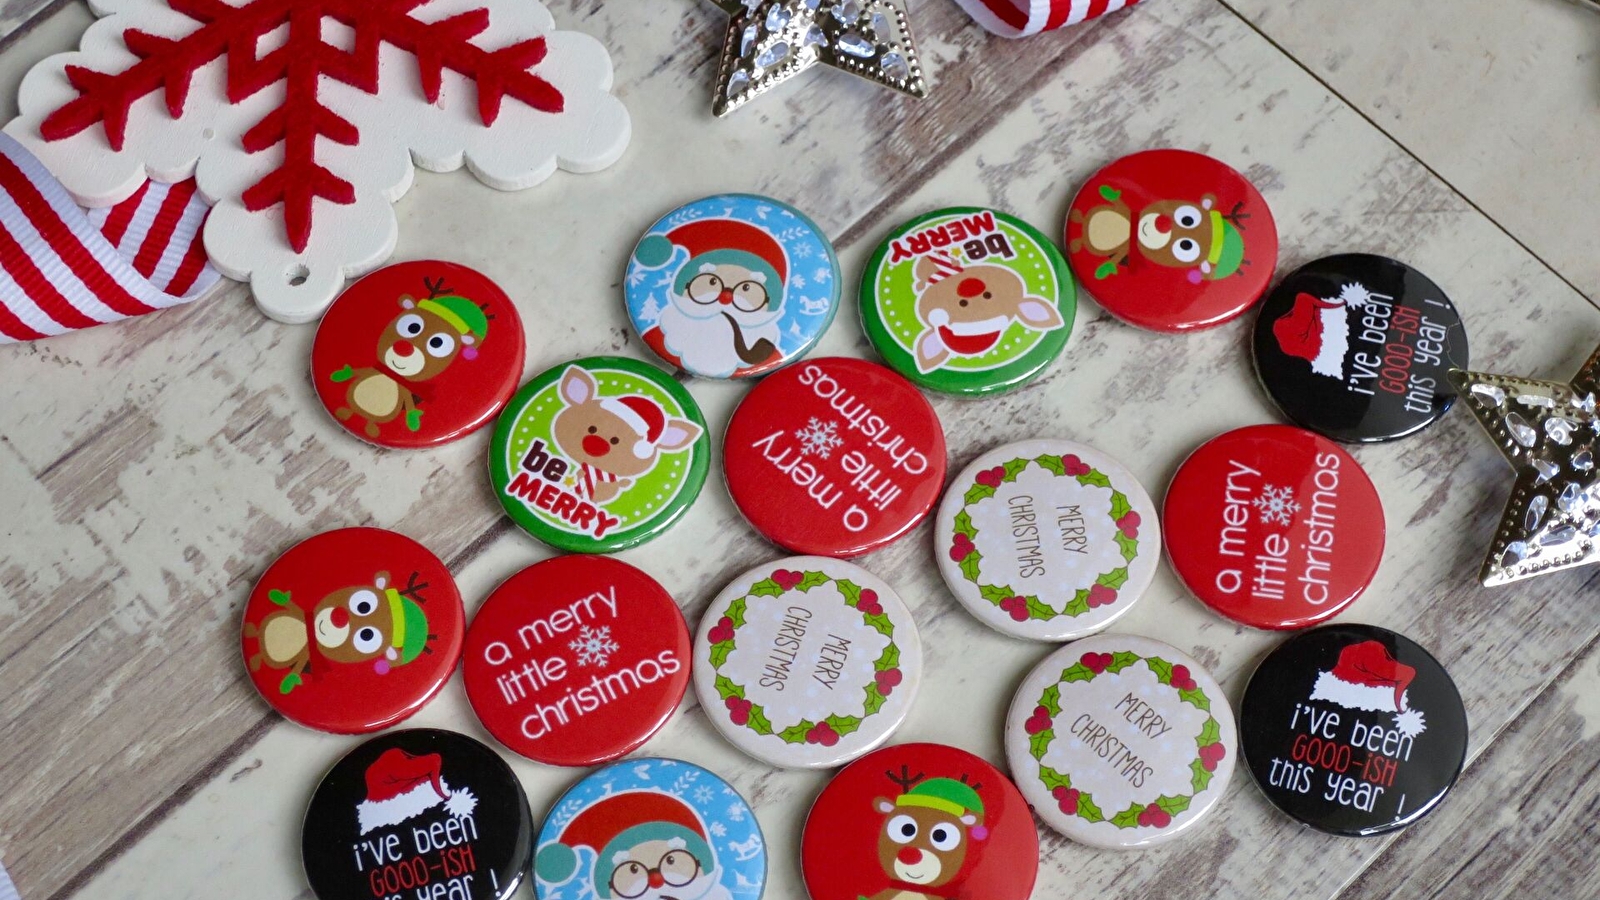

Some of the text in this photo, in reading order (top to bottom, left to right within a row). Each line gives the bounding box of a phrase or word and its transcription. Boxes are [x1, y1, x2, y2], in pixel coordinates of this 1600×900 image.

[890, 212, 994, 263] MERRY
[963, 233, 1014, 260] be
[1347, 292, 1393, 395] i've been
[1414, 316, 1447, 366] year
[798, 365, 928, 475] christmas
[1404, 373, 1436, 413] this
[522, 440, 568, 482] be
[752, 430, 868, 532] a merry
[841, 451, 902, 511] little
[508, 472, 618, 537] MERRY
[1056, 504, 1088, 555] MERRY
[1215, 459, 1262, 593] a merry
[1298, 453, 1340, 605] christmas
[1007, 495, 1045, 579] CHRISTMAS
[1252, 533, 1290, 600] little
[484, 585, 617, 665] a merry
[759, 606, 813, 692] CHRISTMAS
[496, 656, 567, 705] little
[812, 633, 852, 690] MERRY
[521, 650, 681, 739] christmas
[1114, 692, 1172, 739] MERRY
[1070, 713, 1154, 788] CHRISTMAS
[1290, 703, 1413, 762] i've been
[1269, 757, 1314, 793] this
[1324, 772, 1384, 813] year
[353, 814, 478, 871] i've been
